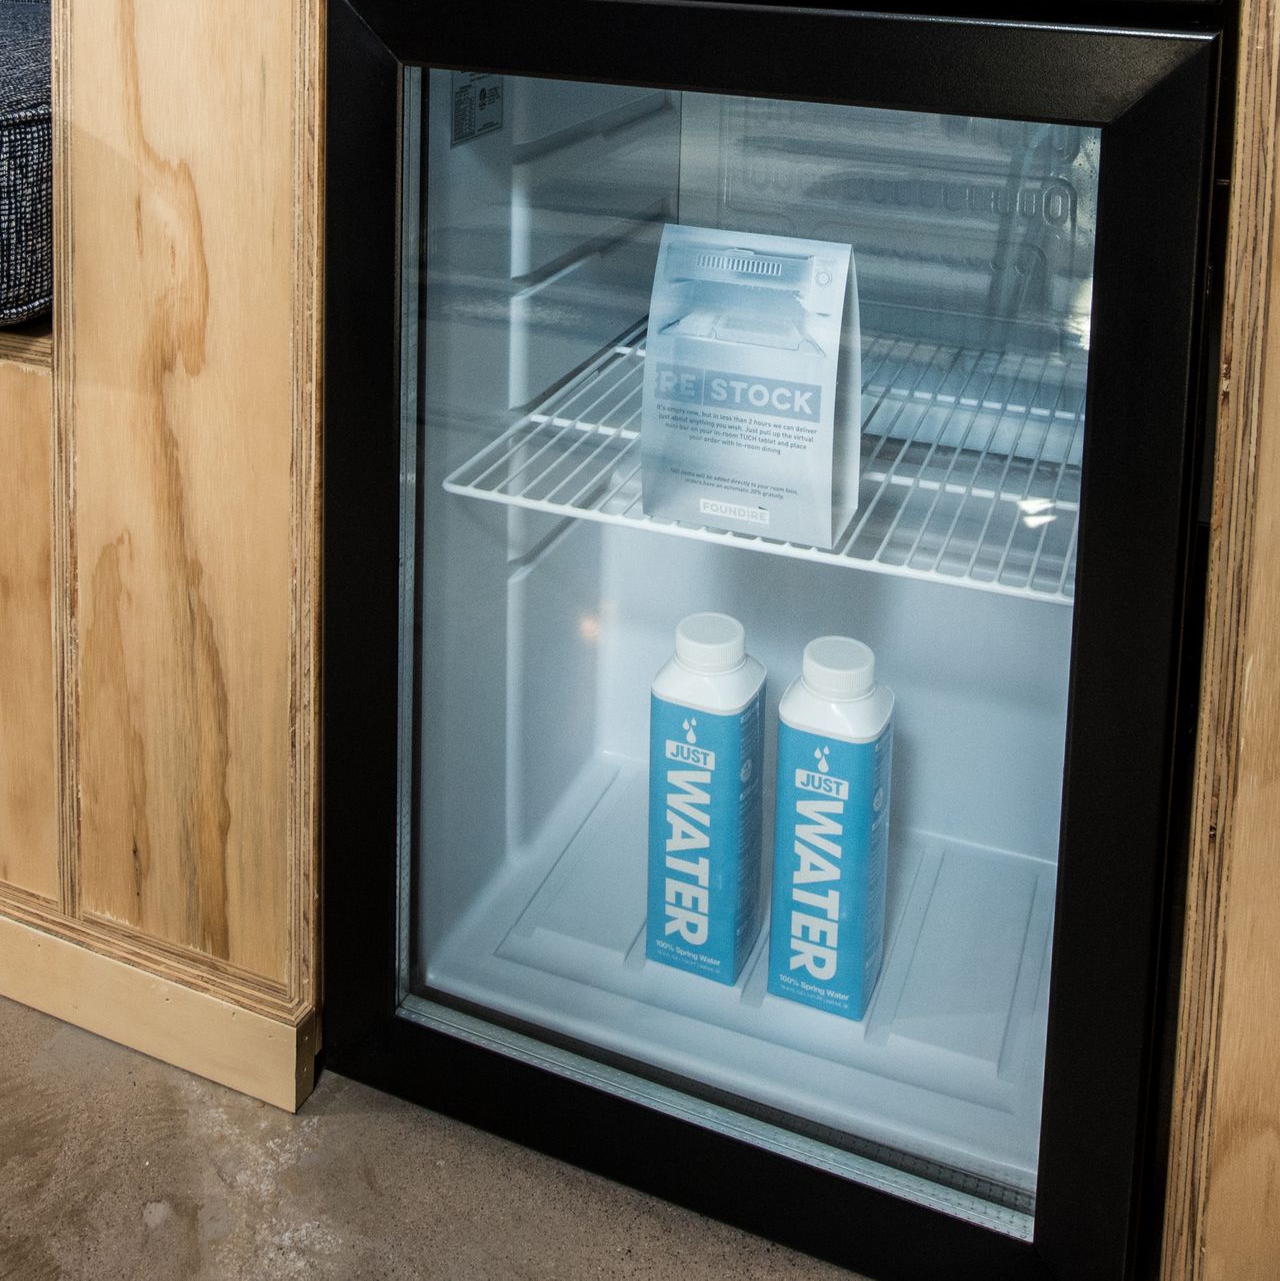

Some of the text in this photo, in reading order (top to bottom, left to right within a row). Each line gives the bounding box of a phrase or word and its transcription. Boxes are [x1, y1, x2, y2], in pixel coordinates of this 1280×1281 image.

[711, 377, 813, 415] STOCK
[689, 417, 715, 428] anything
[716, 422, 727, 430] you
[746, 425, 758, 433] Just
[759, 428, 771, 436] pull
[793, 434, 814, 442] virtual
[754, 419, 771, 428] hours
[795, 425, 817, 434] deliver
[704, 436, 720, 444] order
[722, 439, 735, 447] with
[736, 441, 761, 451] in-room
[762, 446, 781, 455] dining
[714, 430, 738, 438] in-room
[758, 436, 776, 445] tablet
[777, 439, 789, 447] and
[790, 442, 807, 450] place
[670, 744, 710, 766] JUST
[800, 773, 844, 796] JUST
[664, 770, 711, 946] WATER
[789, 800, 845, 981] WATER
[675, 946, 699, 960] Spring
[699, 953, 721, 967] Water
[779, 973, 800, 987] 100%
[800, 981, 825, 996] Spring
[826, 989, 850, 1001] Water
